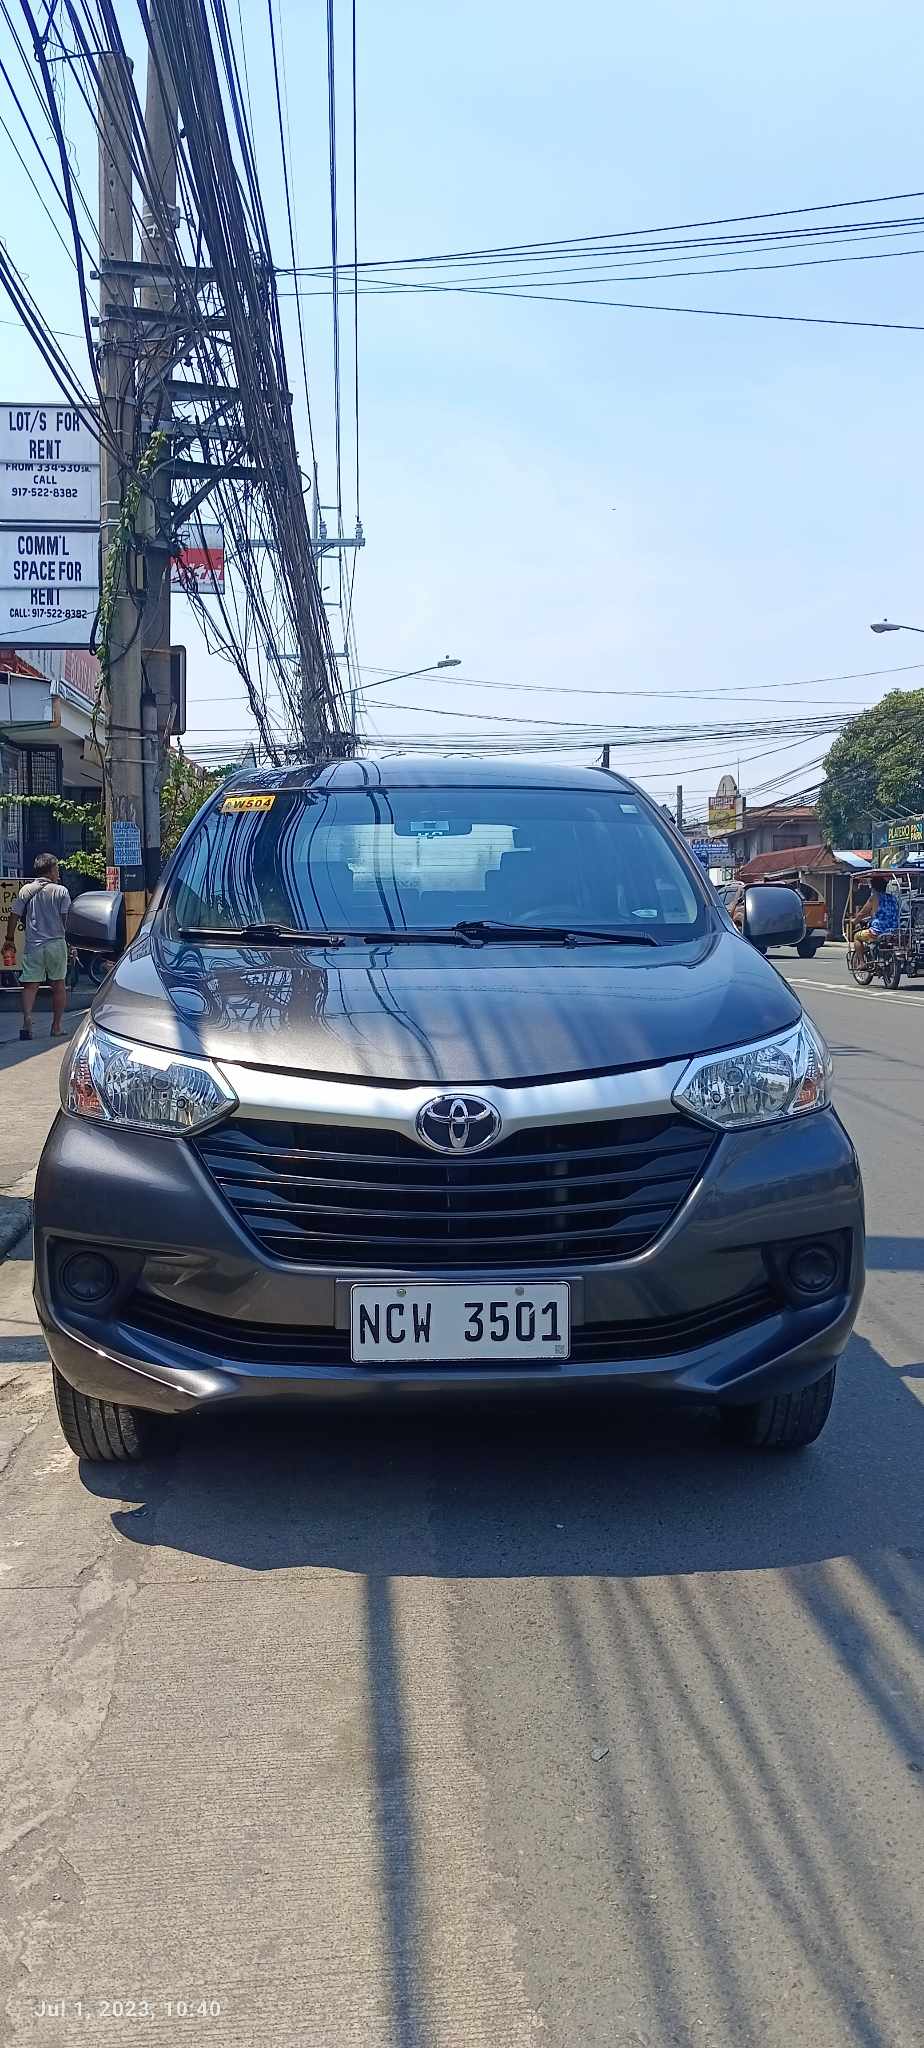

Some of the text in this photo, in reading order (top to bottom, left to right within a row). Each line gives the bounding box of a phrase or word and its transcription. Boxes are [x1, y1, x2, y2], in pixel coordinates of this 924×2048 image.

[9, 410, 80, 433] LOT/S FOR
[29, 439, 62, 459] RENT
[5, 463, 34, 472] FROM
[33, 475, 57, 485] CALL
[11, 487, 78, 498] 917-522-8382
[17, 535, 70, 556] COMM'L
[13, 560, 82, 582] SPACE FOR
[30, 588, 60, 606] RENT
[9, 607, 88, 619] CALL: 917-522-8382
[359, 1300, 562, 1345] NCW 3501
